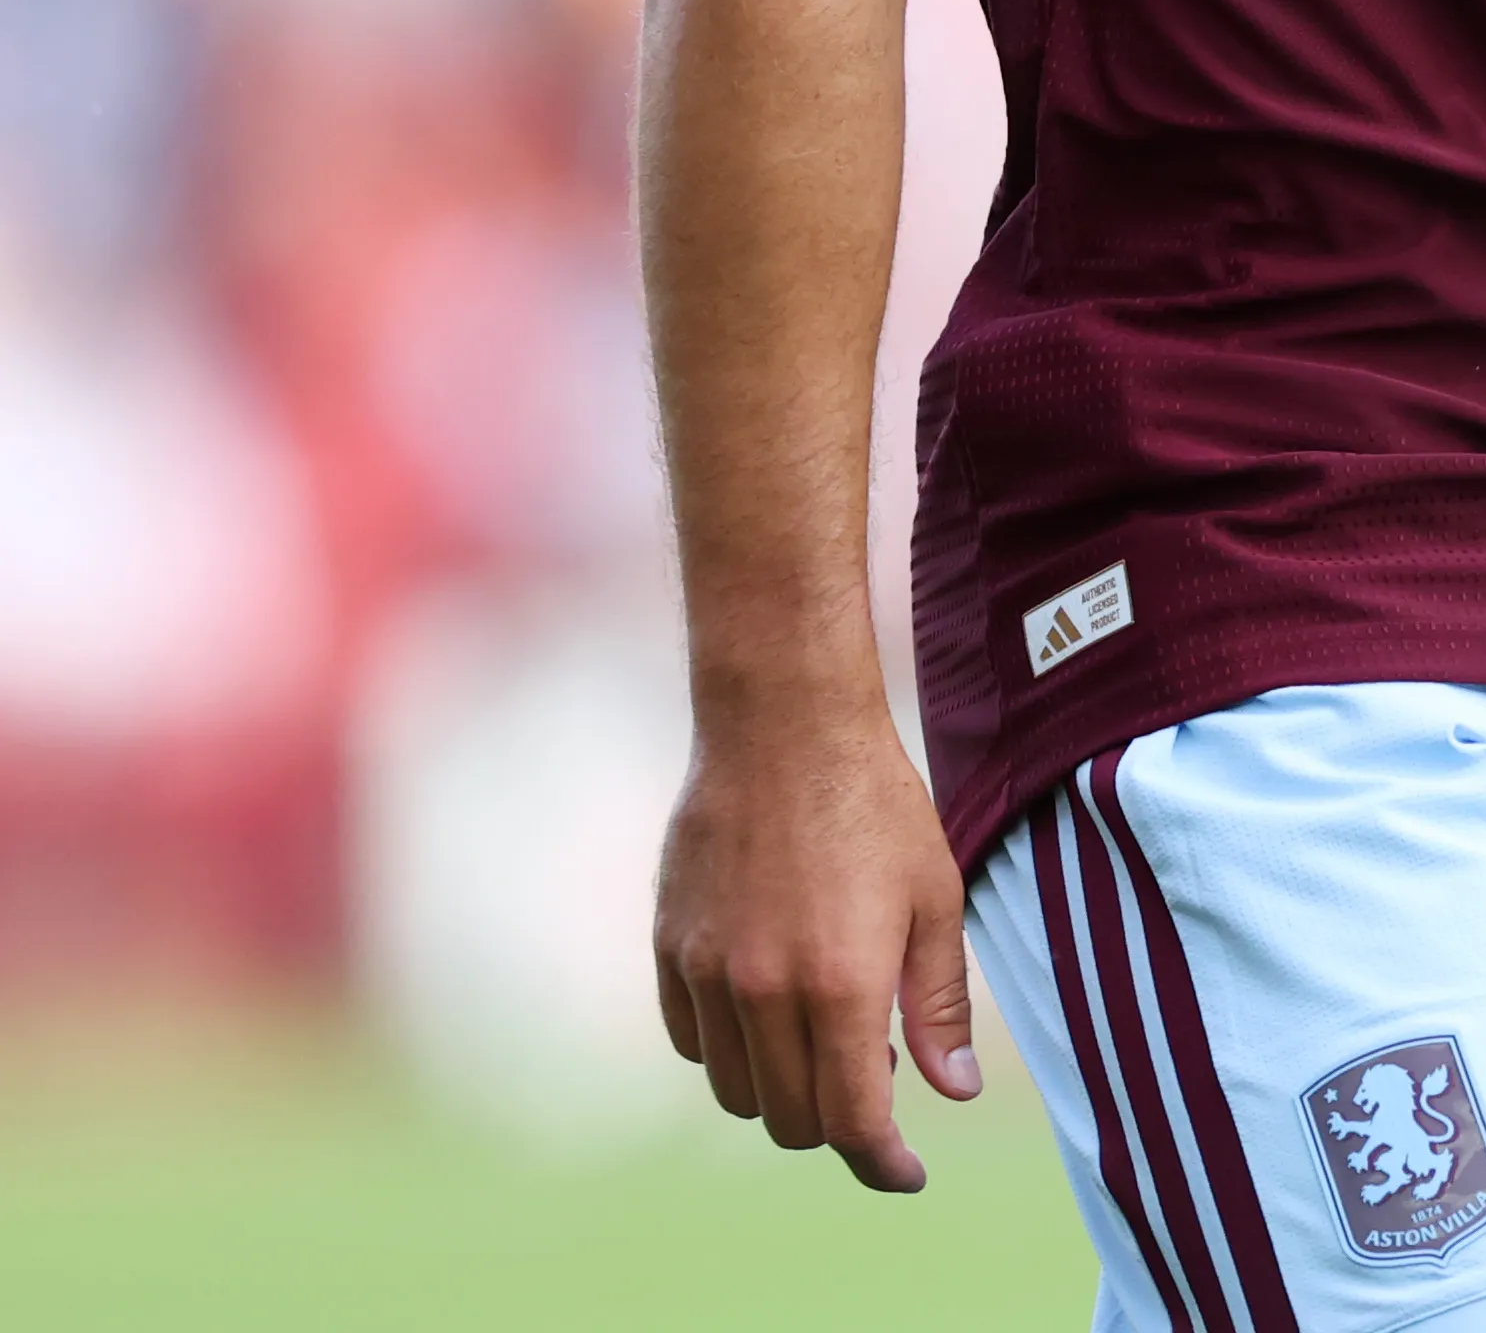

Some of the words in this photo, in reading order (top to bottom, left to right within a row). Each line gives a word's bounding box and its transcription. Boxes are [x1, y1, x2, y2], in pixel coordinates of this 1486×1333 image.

[1081, 577, 1116, 605] AUTHENTIC
[1087, 593, 1119, 617] LICENSED
[1090, 608, 1120, 633] PRODUCT
[1410, 1204, 1443, 1224] 1874
[1365, 1225, 1438, 1247] ASTON
